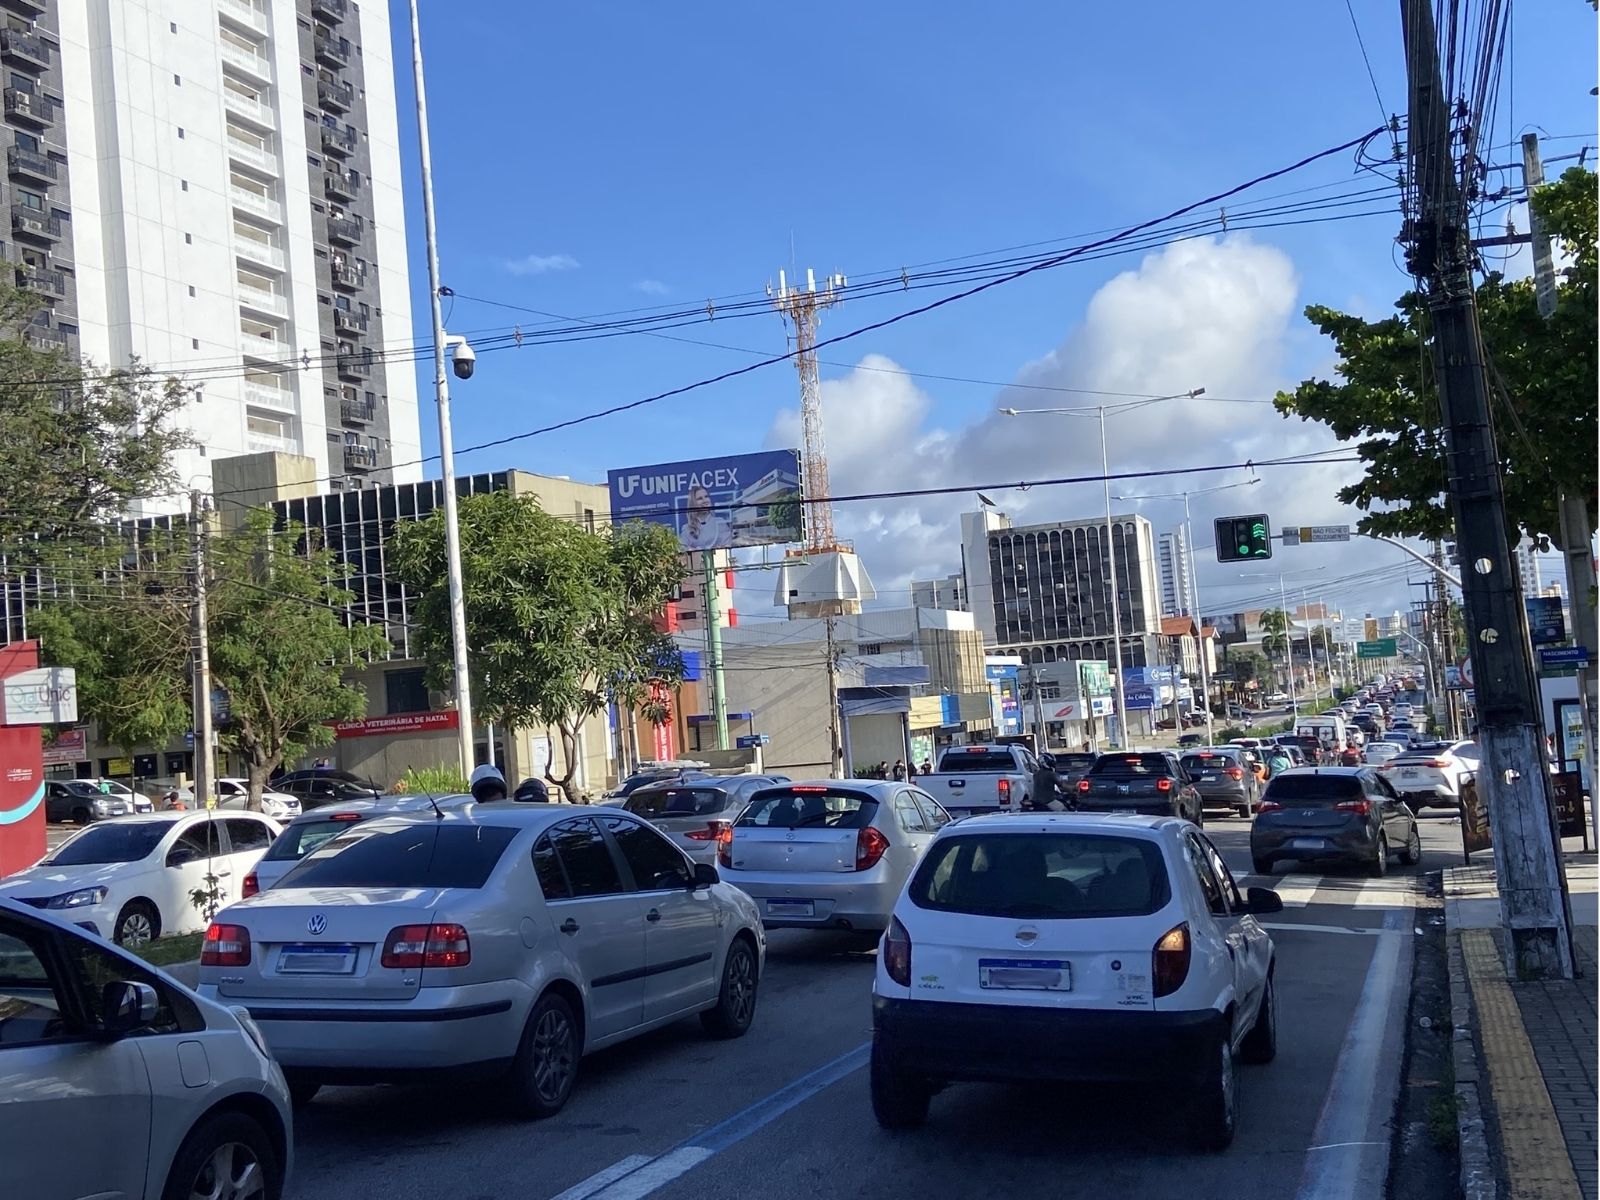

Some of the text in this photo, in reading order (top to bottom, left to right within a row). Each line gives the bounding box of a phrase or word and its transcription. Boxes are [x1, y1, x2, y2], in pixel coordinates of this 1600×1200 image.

[1543, 649, 1579, 657] NASCIMENTO
[337, 720, 365, 730] CLÍNICA
[366, 716, 413, 728] VETERINÁRIA
[414, 715, 425, 723] DE
[425, 714, 449, 722] NATAL
[220, 976, 245, 985] POLO
